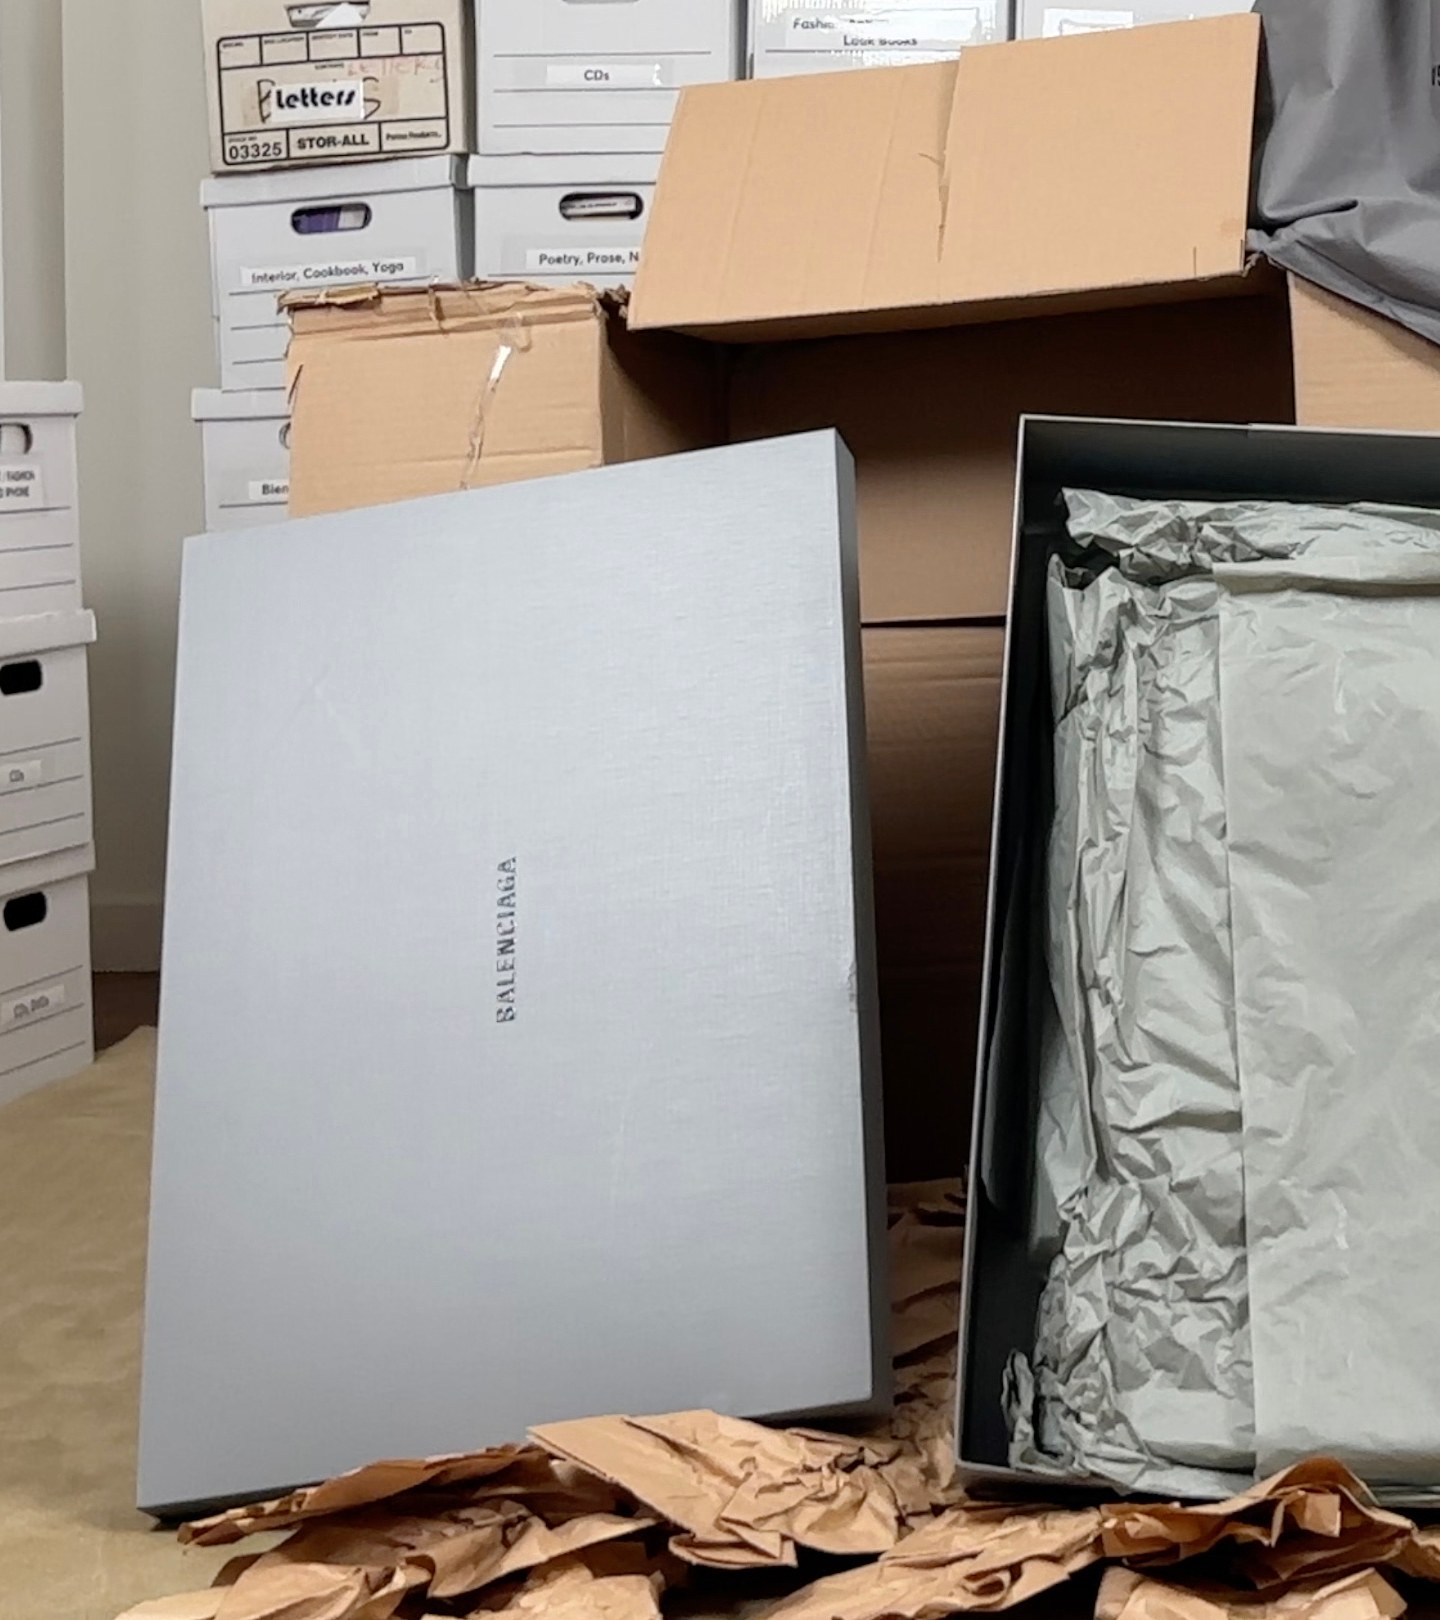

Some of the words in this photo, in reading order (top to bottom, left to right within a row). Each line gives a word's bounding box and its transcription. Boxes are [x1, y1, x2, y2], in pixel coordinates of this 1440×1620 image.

[792, 18, 836, 30] Fashio
[583, 68, 610, 82] CDs
[276, 87, 355, 110] letters
[297, 134, 370, 150] STOR-ALL
[229, 142, 282, 160] 03325
[538, 253, 583, 267] Poetry,
[587, 251, 626, 265] Prose,
[629, 251, 640, 262] N
[251, 269, 300, 284] Interior,
[303, 263, 369, 281] Cookbook,
[372, 261, 405, 277] Yoga
[262, 484, 289, 496] Bien
[496, 856, 517, 1024] BALENCIAGA
